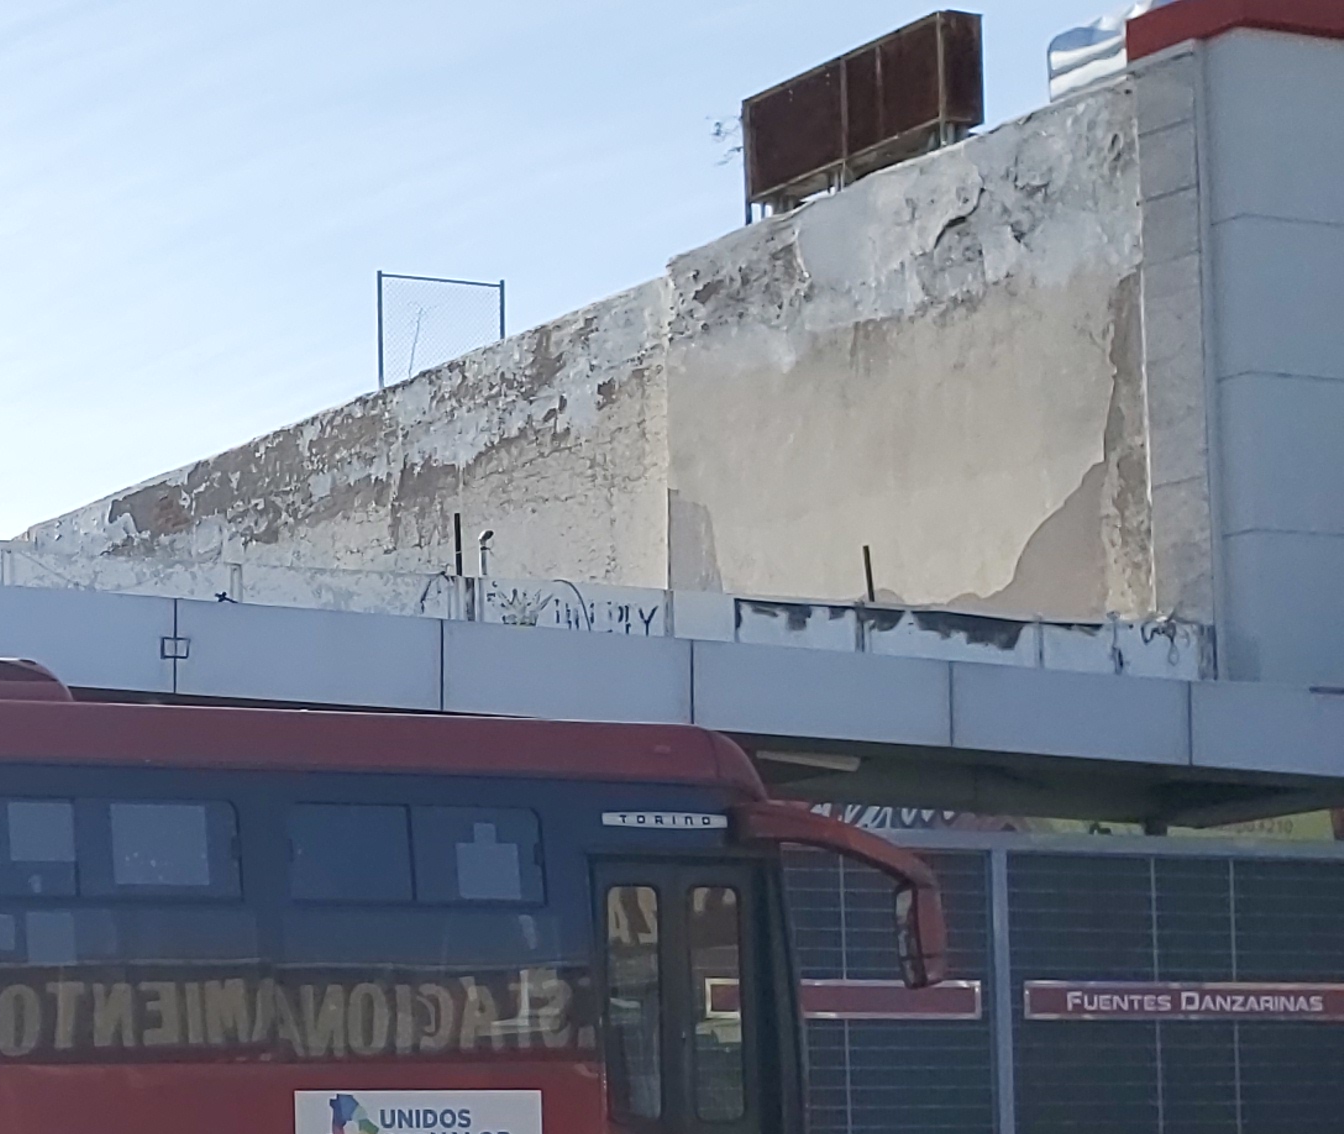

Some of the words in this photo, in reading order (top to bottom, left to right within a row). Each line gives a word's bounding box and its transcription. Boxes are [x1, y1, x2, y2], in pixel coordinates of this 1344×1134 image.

[619, 814, 712, 826] TORINO
[1066, 991, 1172, 1012] FUENTES
[1180, 991, 1324, 1013] DANZARINAS
[379, 1108, 472, 1129] UNIDOS
